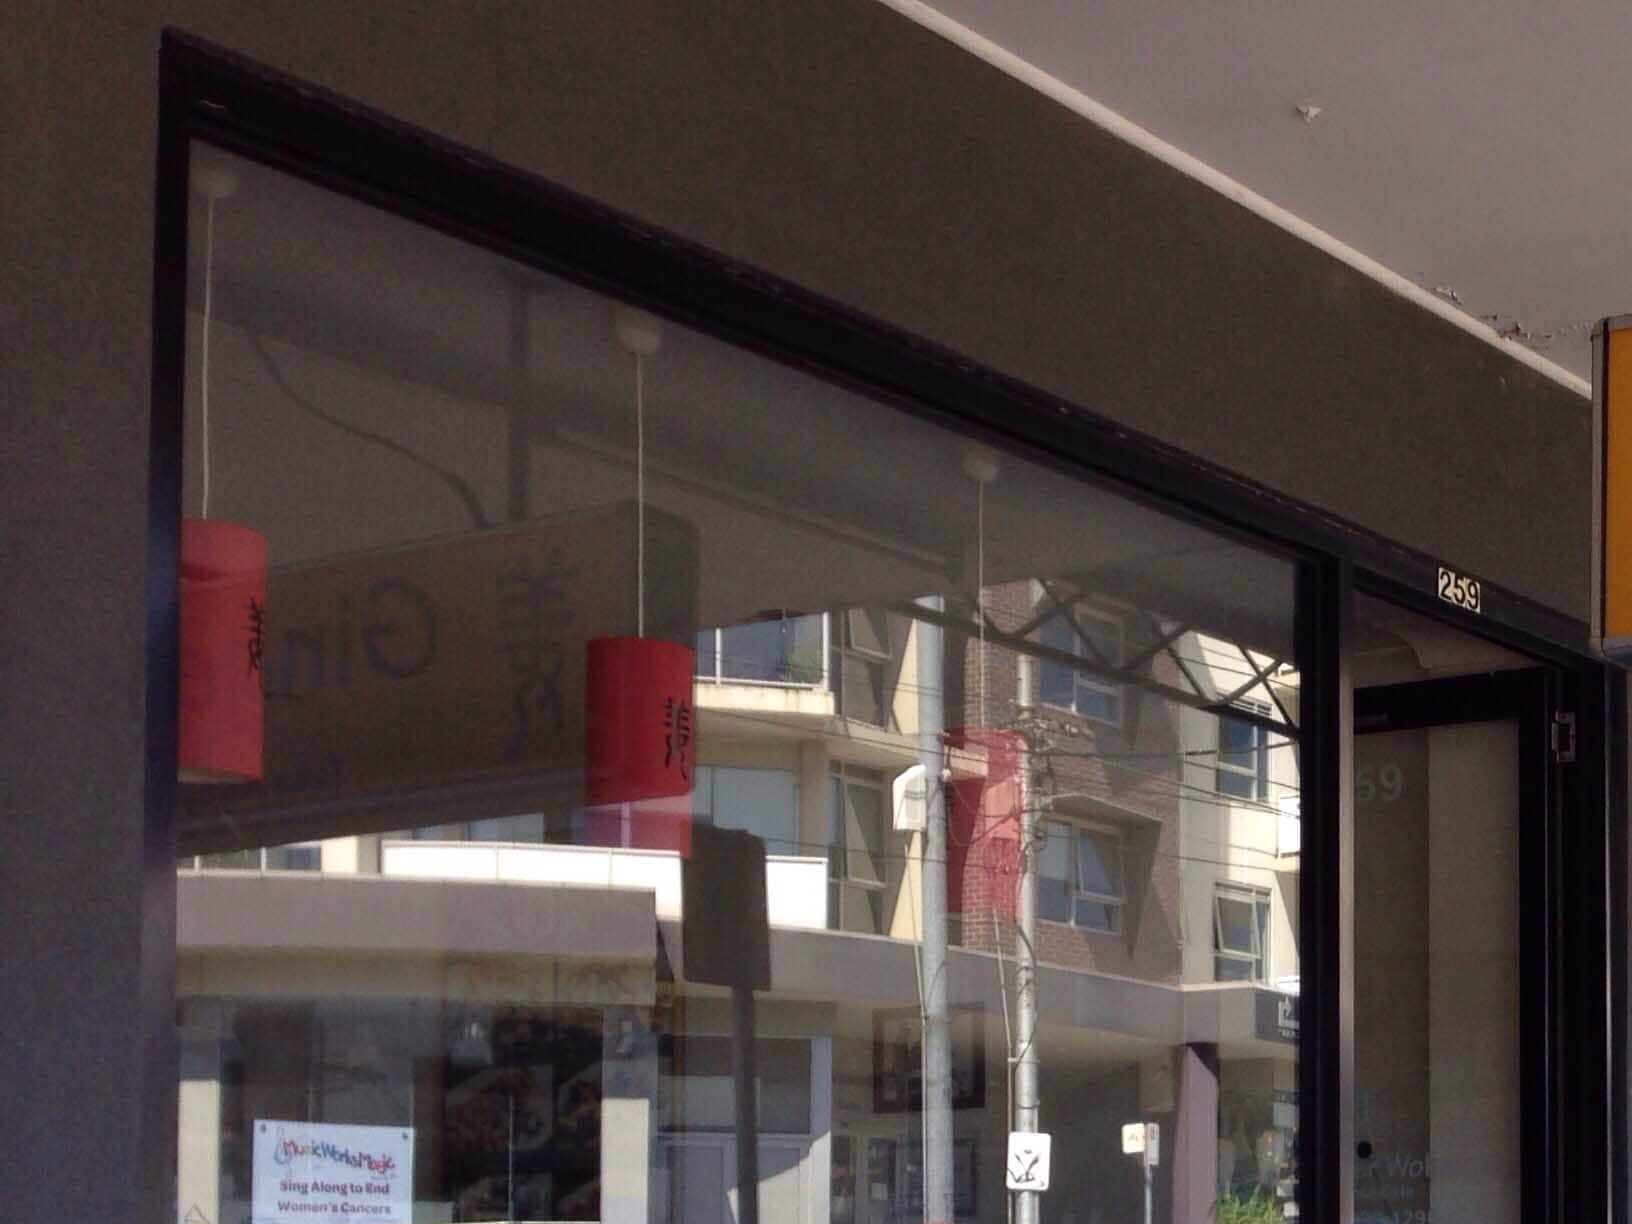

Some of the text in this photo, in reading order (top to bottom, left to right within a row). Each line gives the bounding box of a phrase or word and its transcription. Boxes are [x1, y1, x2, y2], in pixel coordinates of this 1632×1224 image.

[1440, 571, 1479, 610] 259
[280, 1179, 389, 1196] Sing Along to End
[278, 1201, 391, 1214] Women's Cancers
